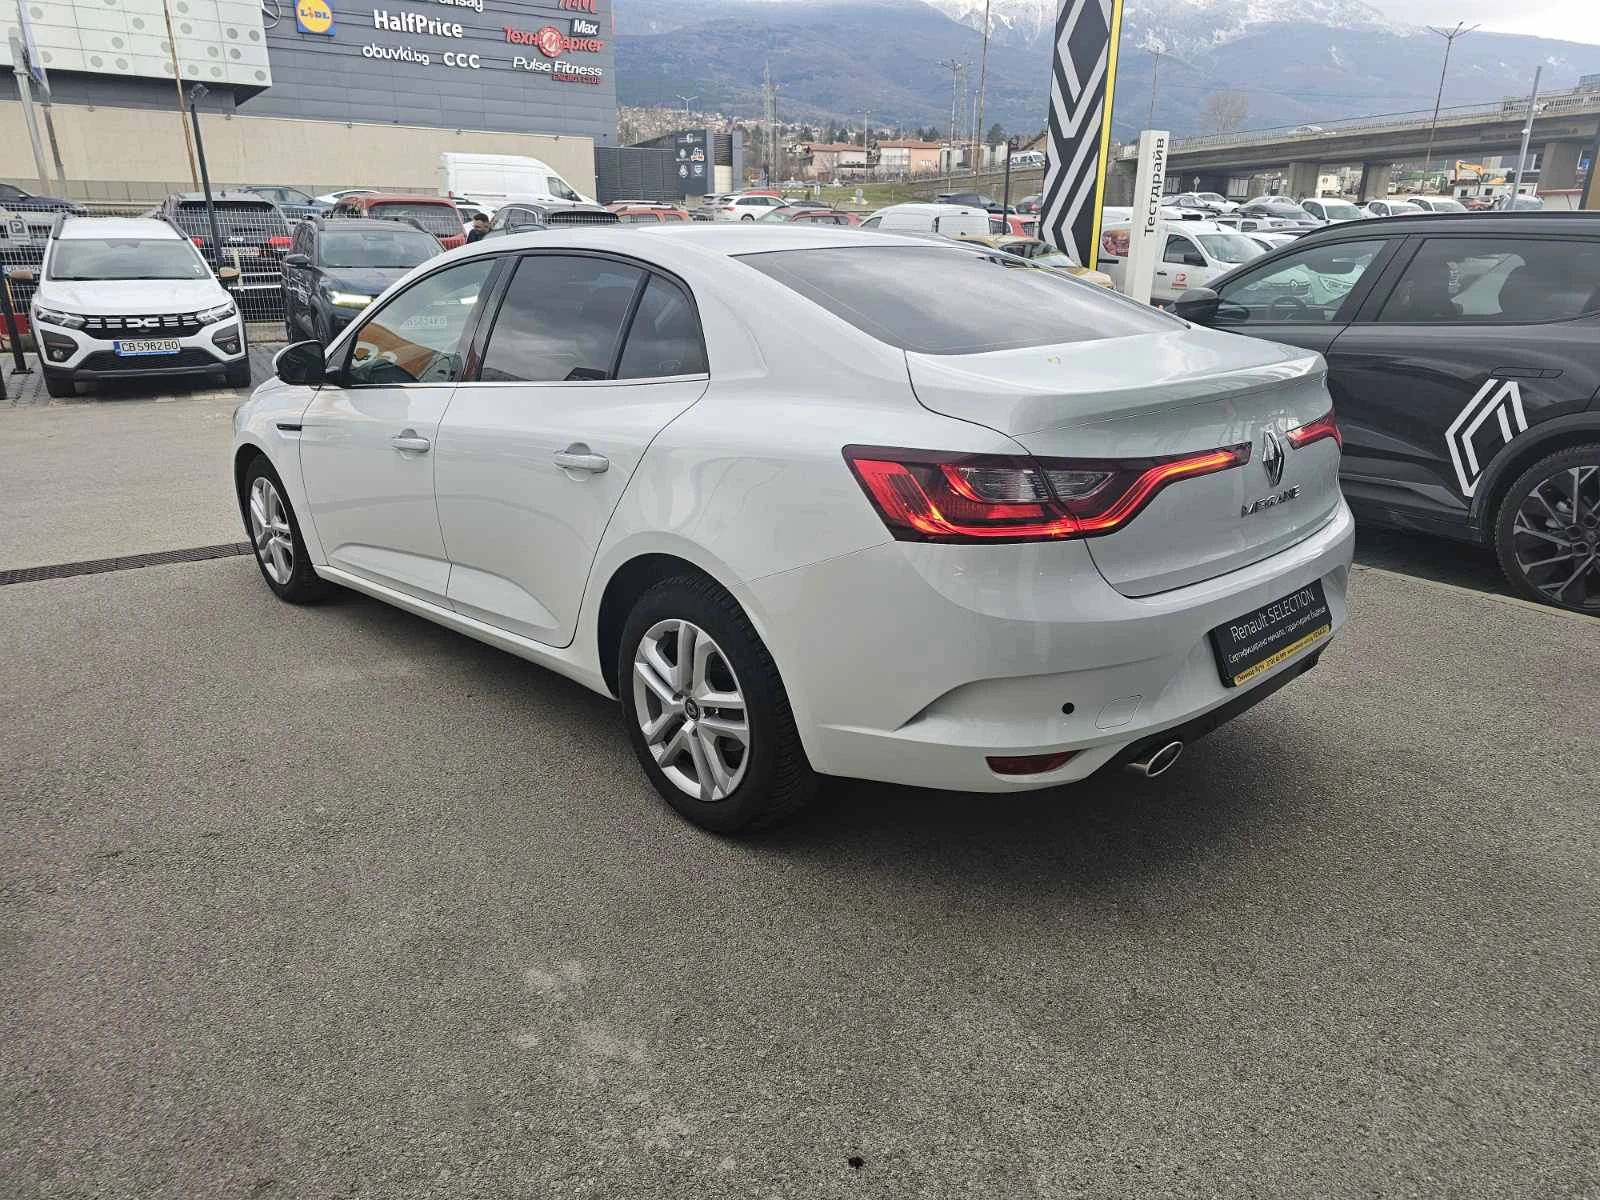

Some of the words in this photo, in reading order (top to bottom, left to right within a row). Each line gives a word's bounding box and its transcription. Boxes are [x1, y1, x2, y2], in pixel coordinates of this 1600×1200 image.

[374, 9, 463, 38] HalfPrice
[574, 19, 598, 34] Max
[362, 43, 430, 66] obuvki.bg
[443, 52, 481, 69] CCC
[513, 56, 551, 72] Pulse
[554, 60, 602, 76] Fitness
[1144, 137, 1165, 237] Тестдрайв
[1230, 610, 1269, 643] Renault
[1267, 587, 1315, 624] SELECTION
